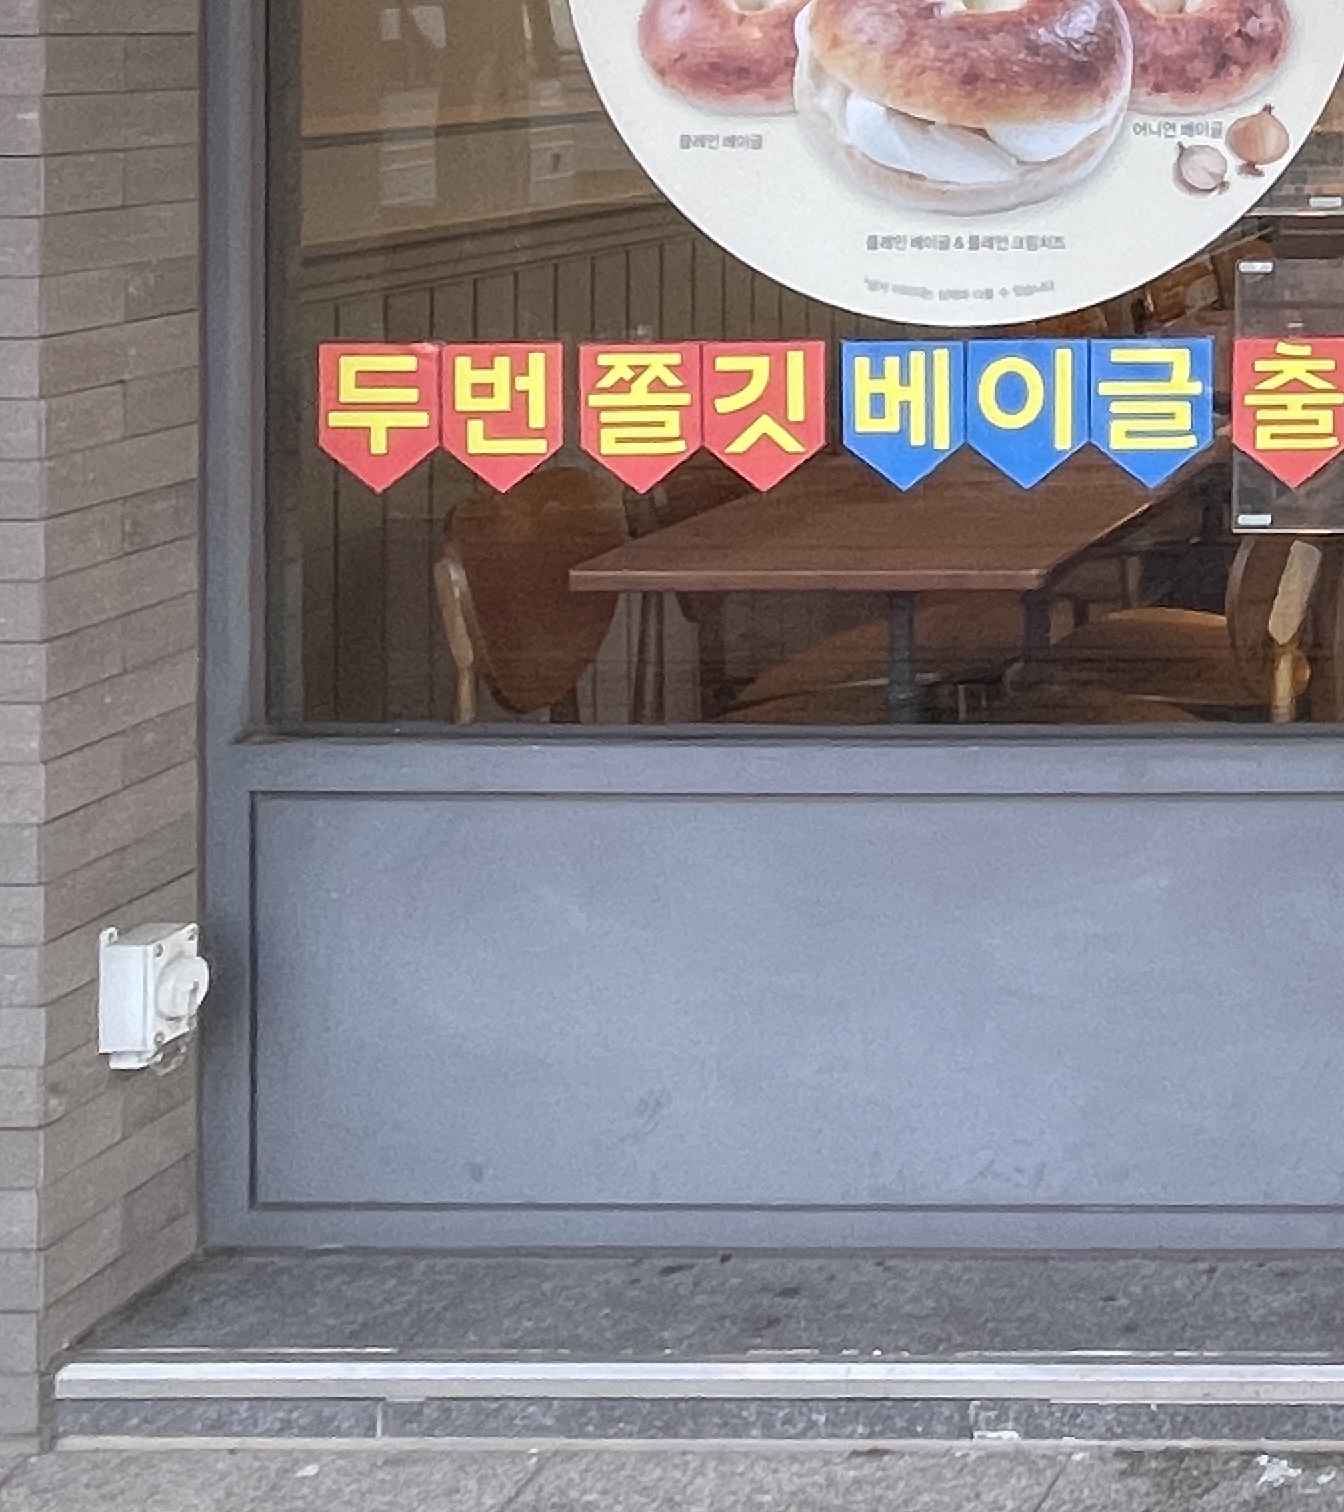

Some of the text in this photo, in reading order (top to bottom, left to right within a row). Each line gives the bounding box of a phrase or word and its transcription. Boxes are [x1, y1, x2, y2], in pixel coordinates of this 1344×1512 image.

[327, 350, 548, 455] 두번
[588, 350, 806, 455] 쫄깃
[853, 346, 1203, 452] 베이글
